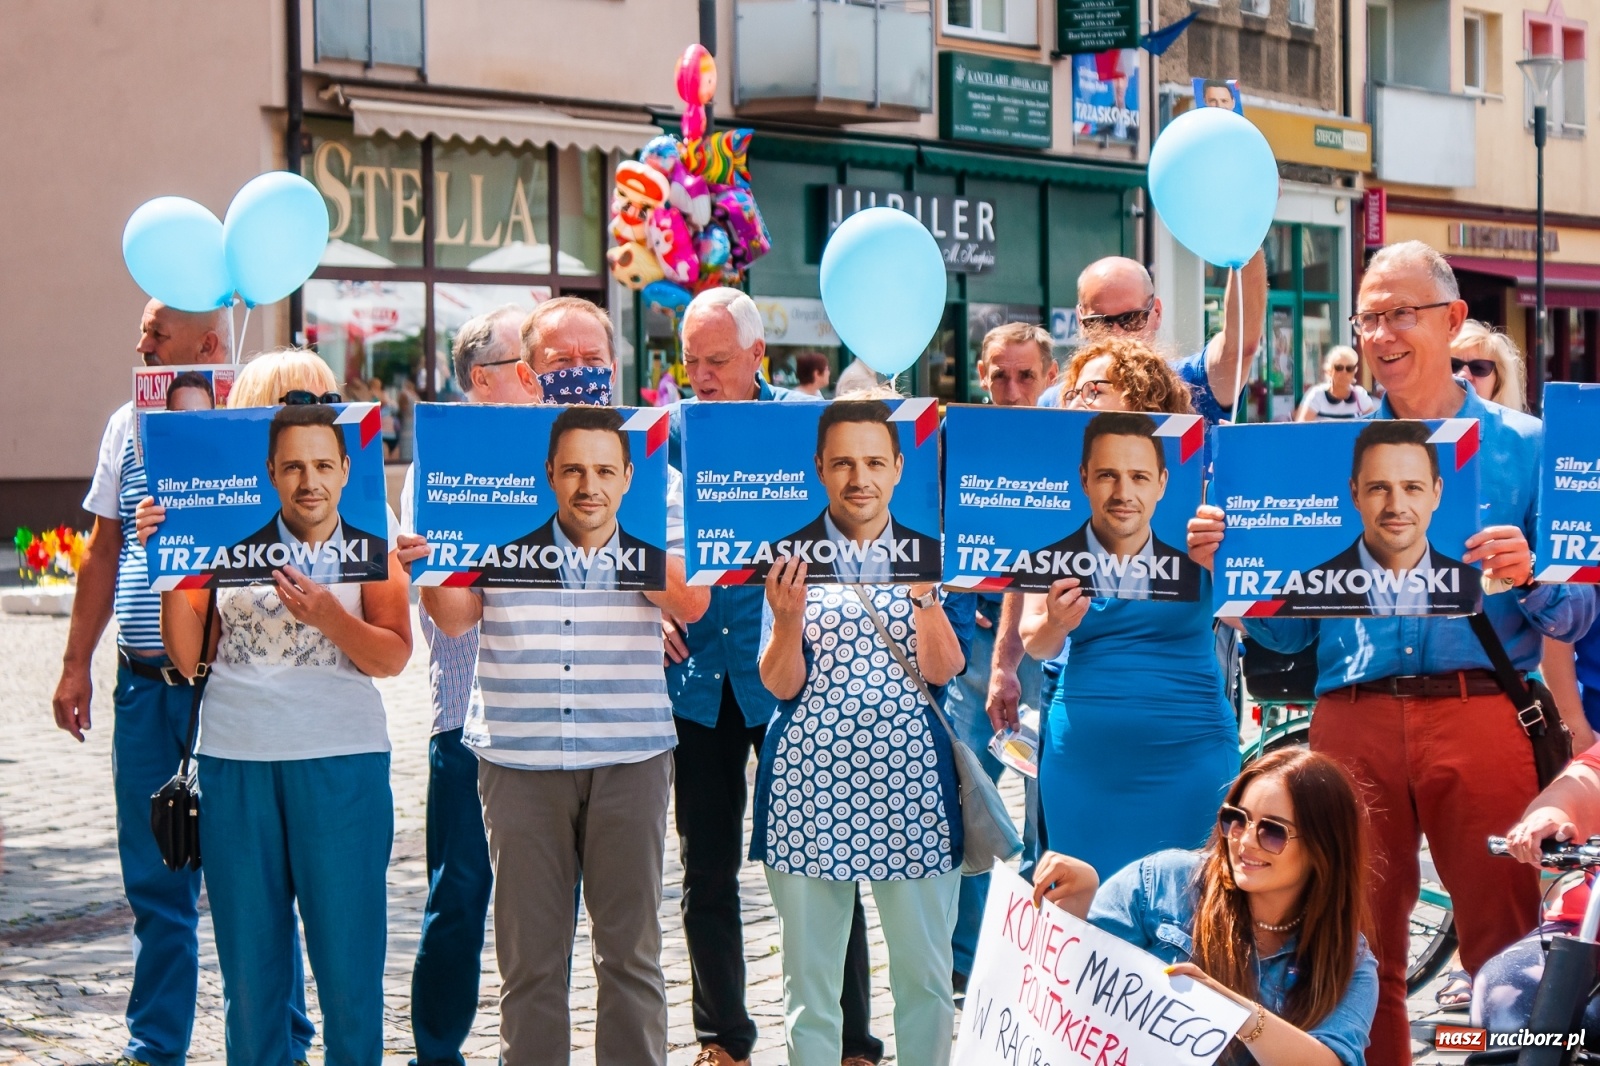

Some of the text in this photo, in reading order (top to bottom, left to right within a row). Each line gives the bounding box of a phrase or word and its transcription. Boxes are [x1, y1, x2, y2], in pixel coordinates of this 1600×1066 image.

[313, 140, 538, 248] STELLA
[1555, 456, 1593, 474] Silny
[157, 474, 258, 493] Silny Prezydent
[427, 472, 535, 489] Silny Prezydent
[696, 470, 805, 485] Silny Prezydent
[960, 475, 1069, 493] Silny Prezydent
[158, 492, 261, 509] Wspólna Polska
[427, 489, 538, 505] Wspólna Polska
[697, 486, 808, 503] Wspólna Polska
[960, 492, 1071, 510] Wspólna Polska
[1226, 494, 1339, 511] Silny Prezydent
[1226, 511, 1342, 529] Wspólna Polska
[1551, 519, 1593, 532] RAFAŁ
[159, 535, 195, 546] RAFAŁ
[426, 529, 463, 541] RAFAŁ
[697, 528, 736, 540] RAFAŁ
[957, 533, 996, 546] RAFAŁ
[157, 538, 369, 571] TRZASKOWSKI
[426, 542, 646, 572] TRZASKOWSKI
[696, 538, 921, 565] TRZASKOWSKI
[957, 547, 1181, 581] TRZASKOWSKI
[1225, 556, 1265, 568] RAFAŁ
[1225, 568, 1460, 595] TRZASKOWSKI
[1075, 950, 1228, 1058] MARNEGO
[972, 989, 994, 1040] W
